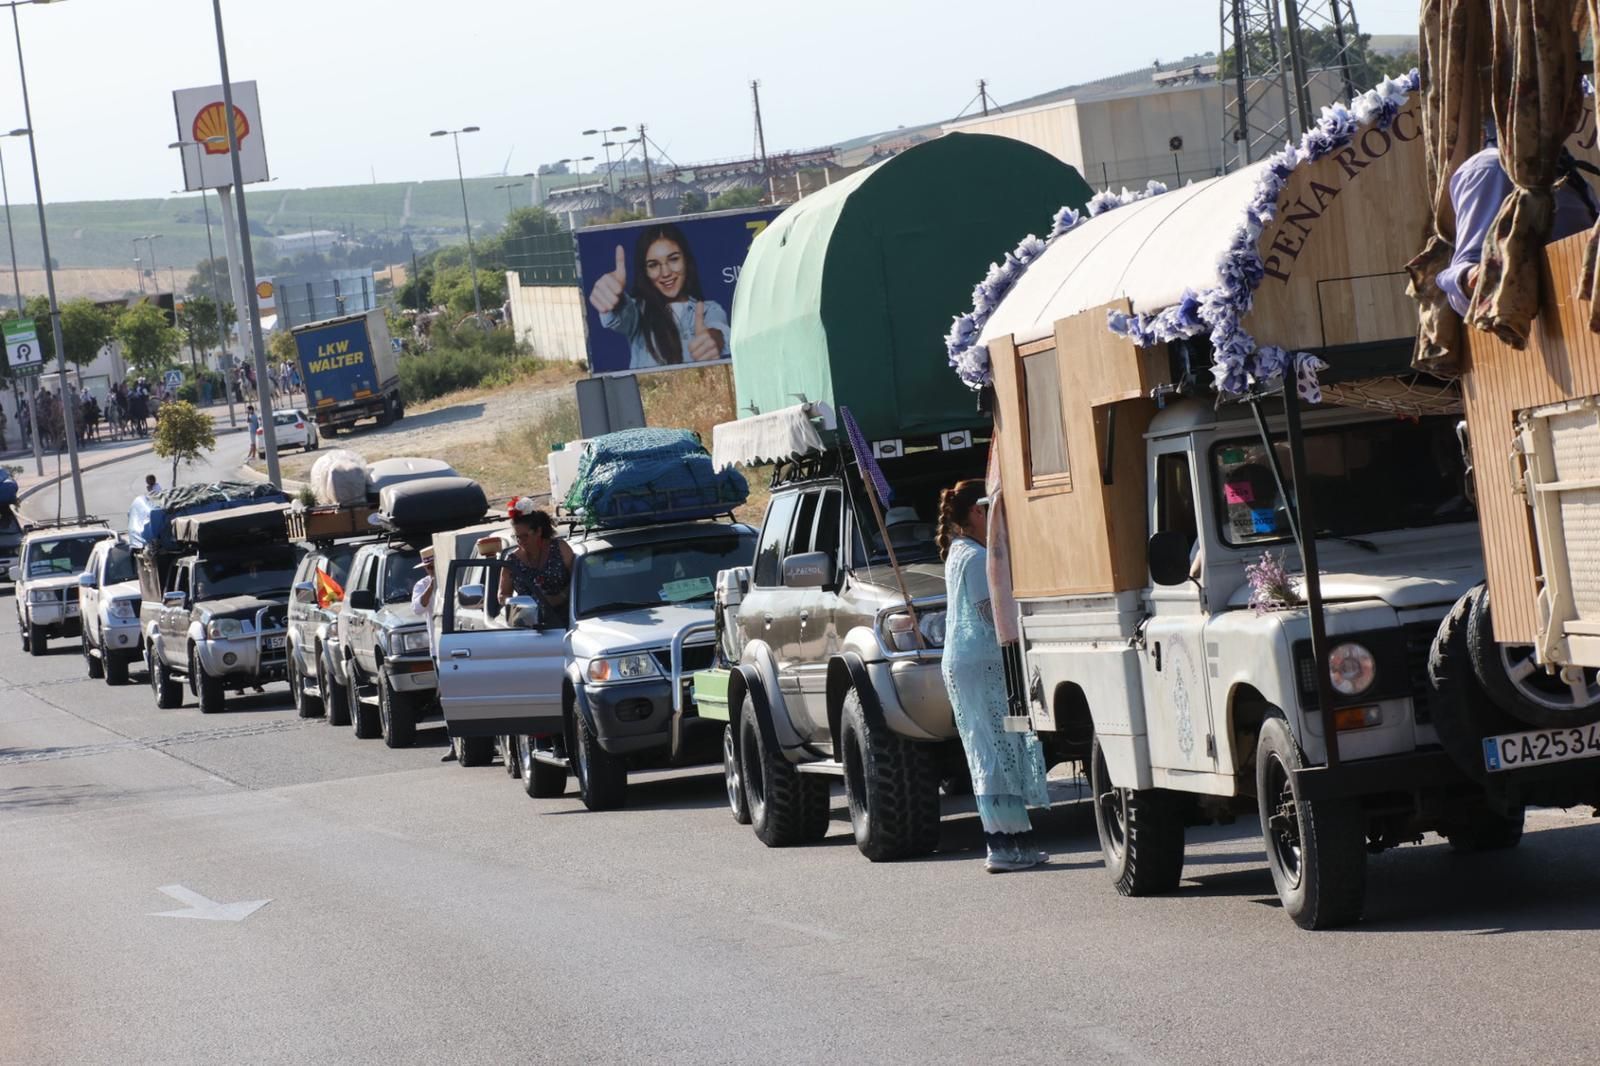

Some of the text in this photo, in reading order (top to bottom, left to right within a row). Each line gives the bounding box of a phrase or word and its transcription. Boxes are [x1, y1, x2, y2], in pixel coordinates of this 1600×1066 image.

[1264, 107, 1424, 286] PEÑA ROC
[318, 340, 349, 357] LKW
[308, 351, 364, 374] WALTER
